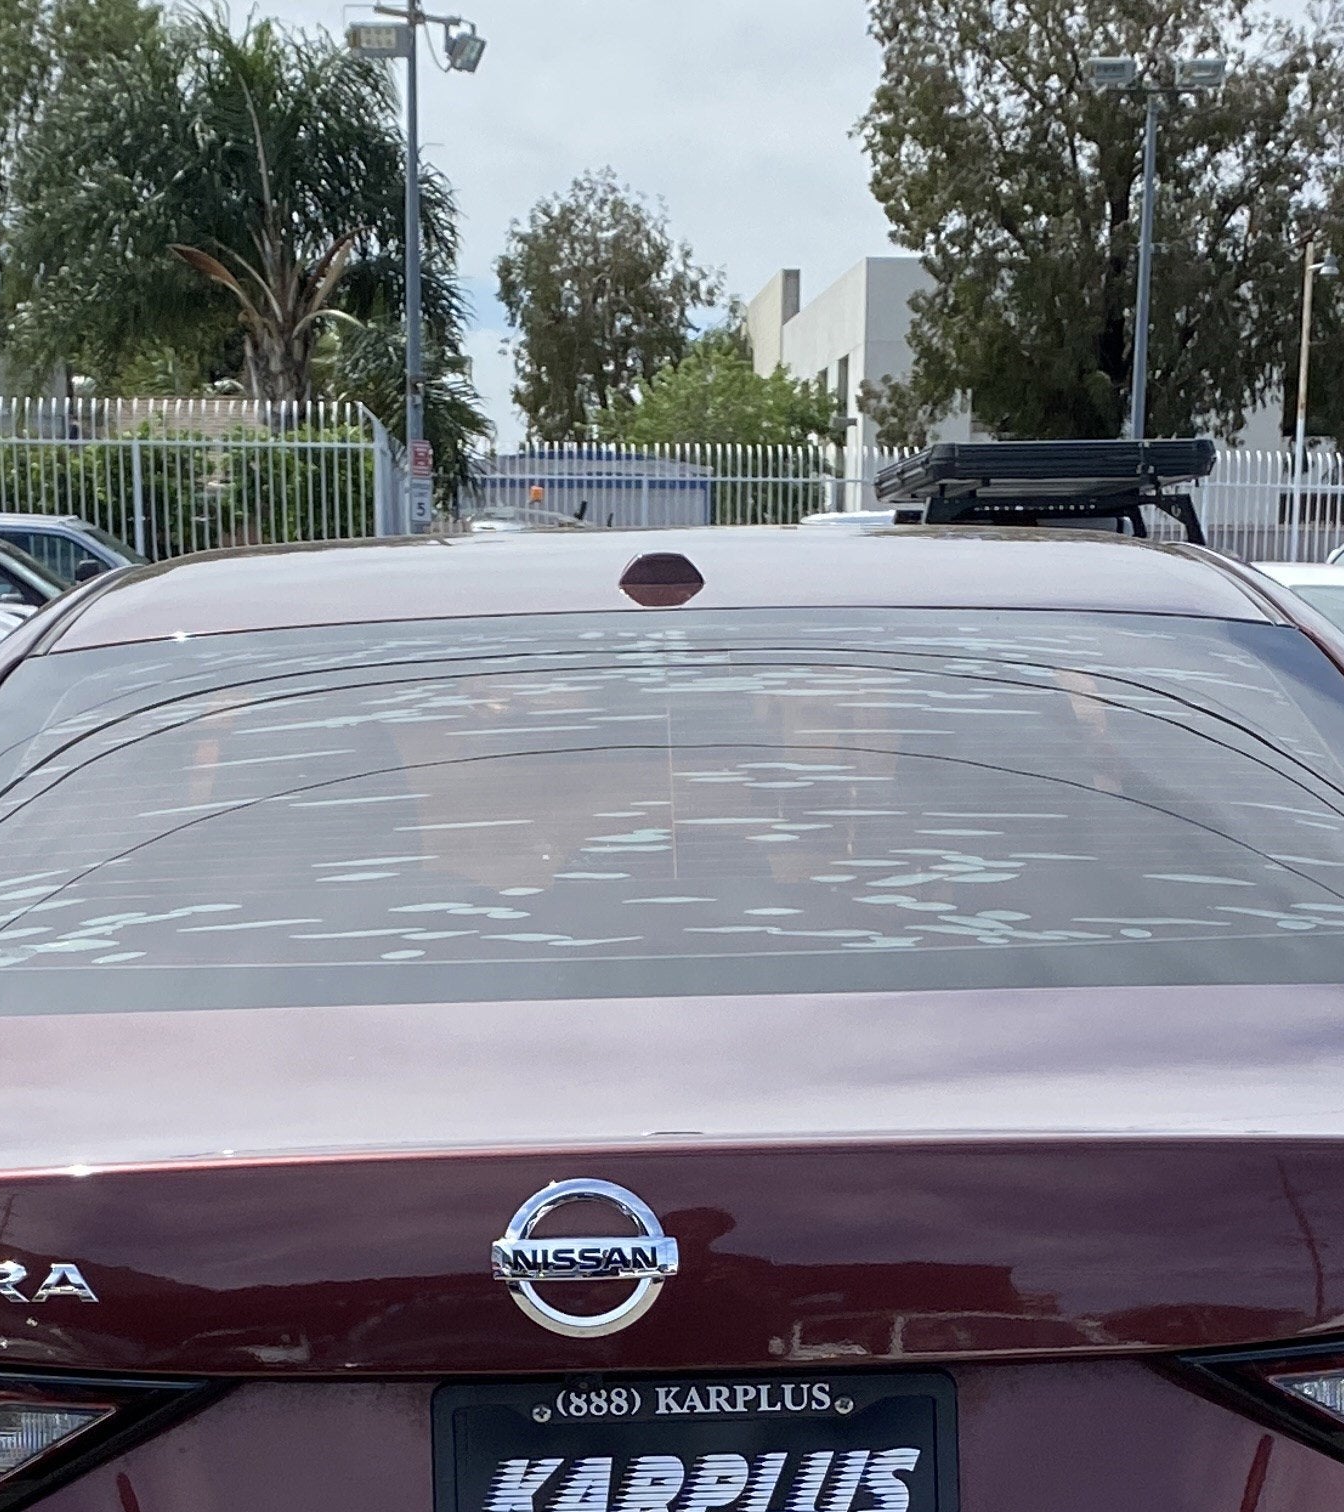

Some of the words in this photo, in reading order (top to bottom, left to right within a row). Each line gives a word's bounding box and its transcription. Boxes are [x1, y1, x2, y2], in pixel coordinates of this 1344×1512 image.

[416, 502, 426, 517] 5
[511, 1246, 658, 1271] NISSAN
[556, 1387, 641, 1417] (888)
[655, 1383, 831, 1414] KARPLUS
